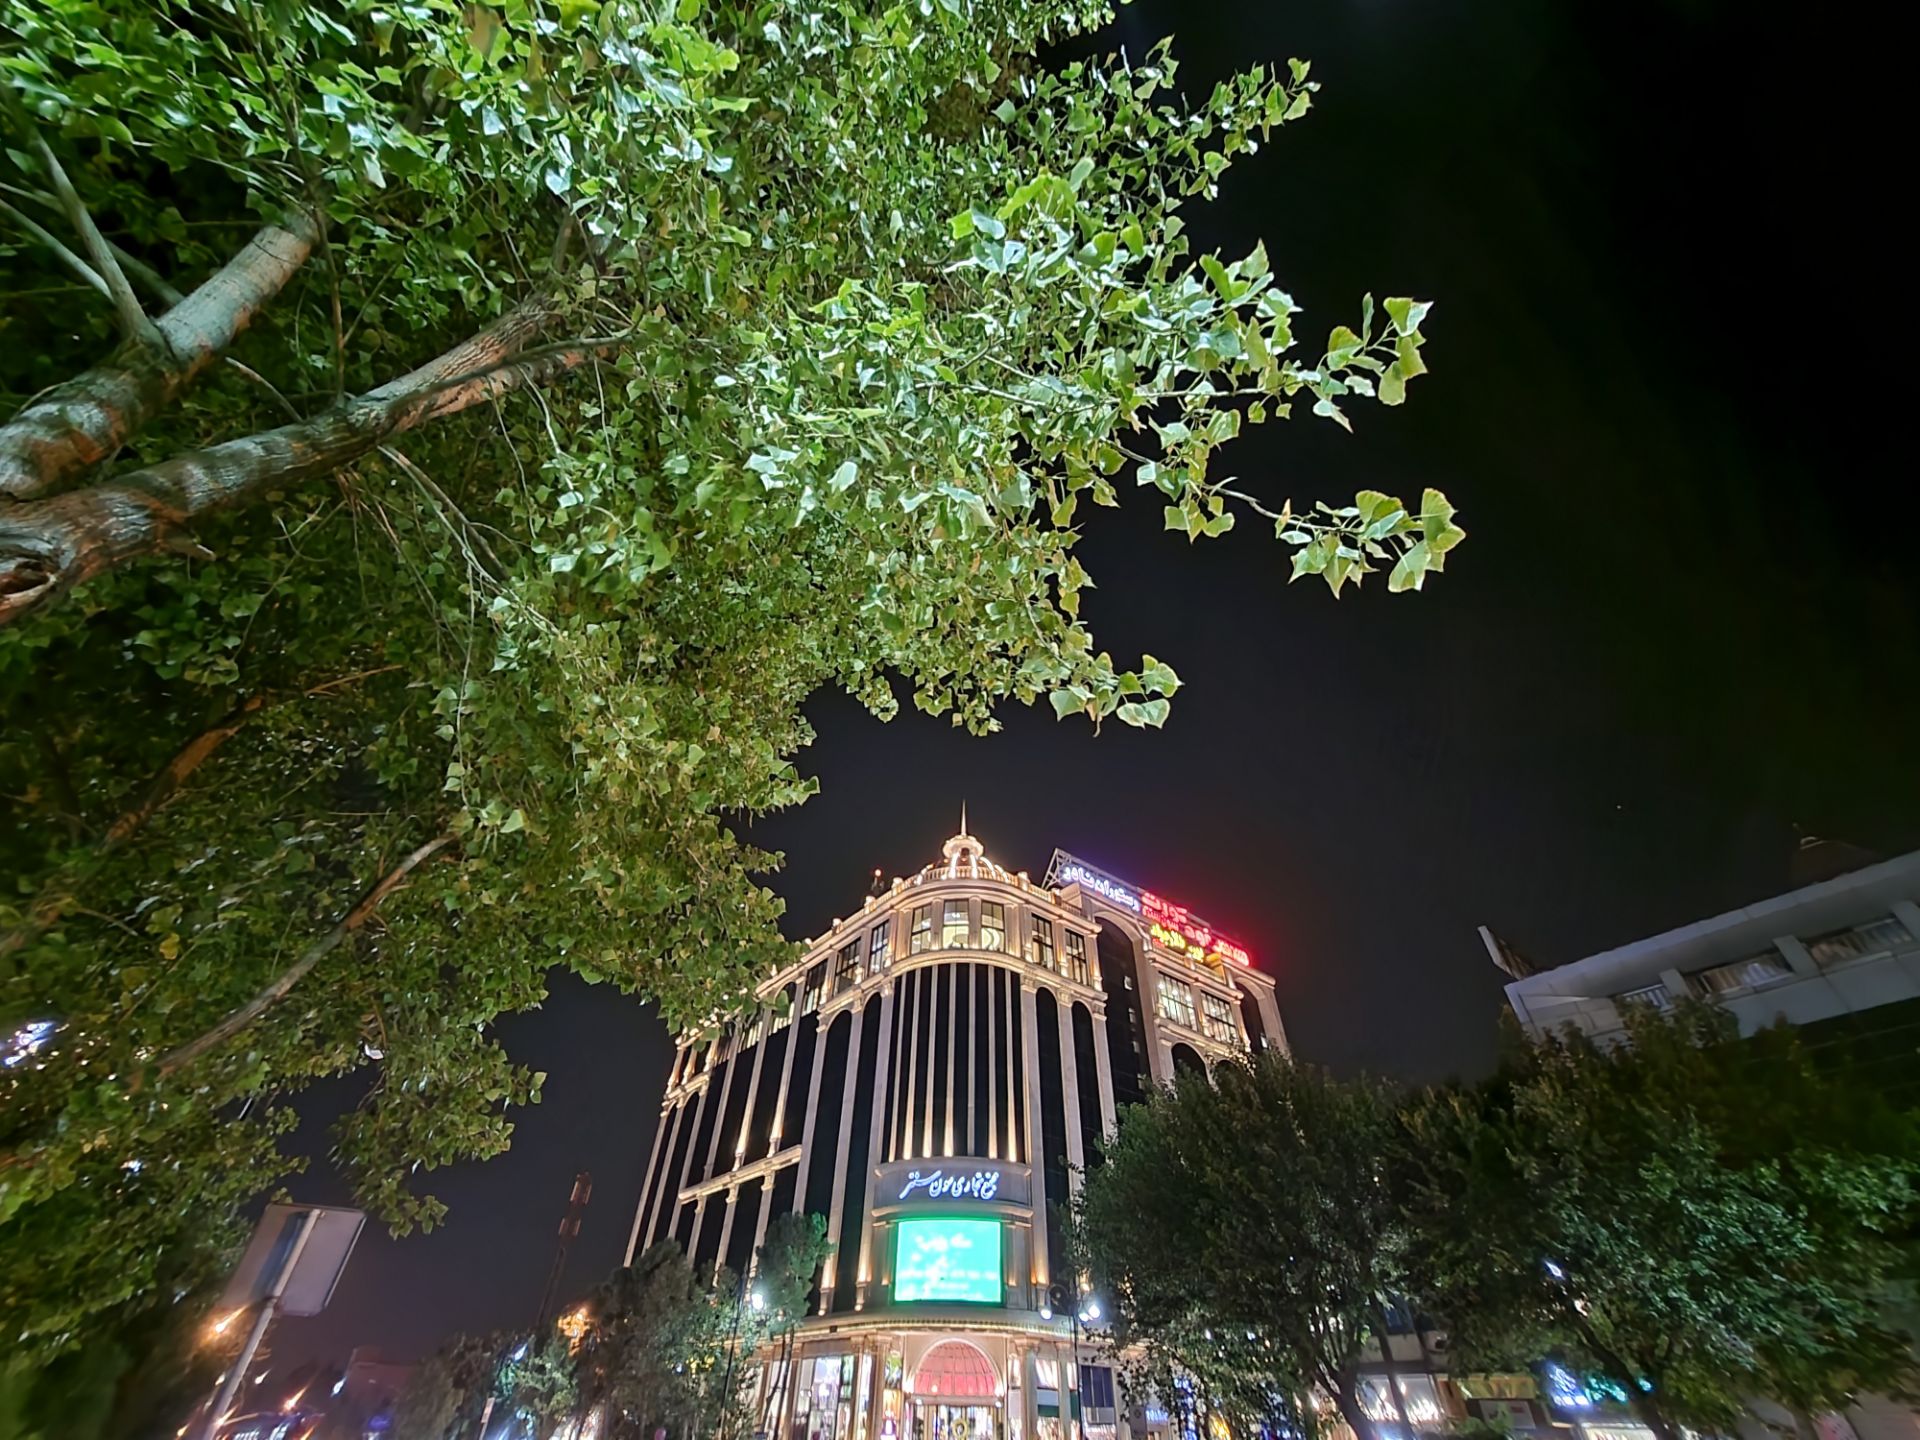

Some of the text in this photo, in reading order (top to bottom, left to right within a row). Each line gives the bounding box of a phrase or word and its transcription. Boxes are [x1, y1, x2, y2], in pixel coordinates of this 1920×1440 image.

[1094, 878, 1140, 912] رستوران
[1140, 891, 1188, 924] کورت
[899, 1170, 942, 1199] سنتر
[951, 1172, 984, 1198] تجاری
